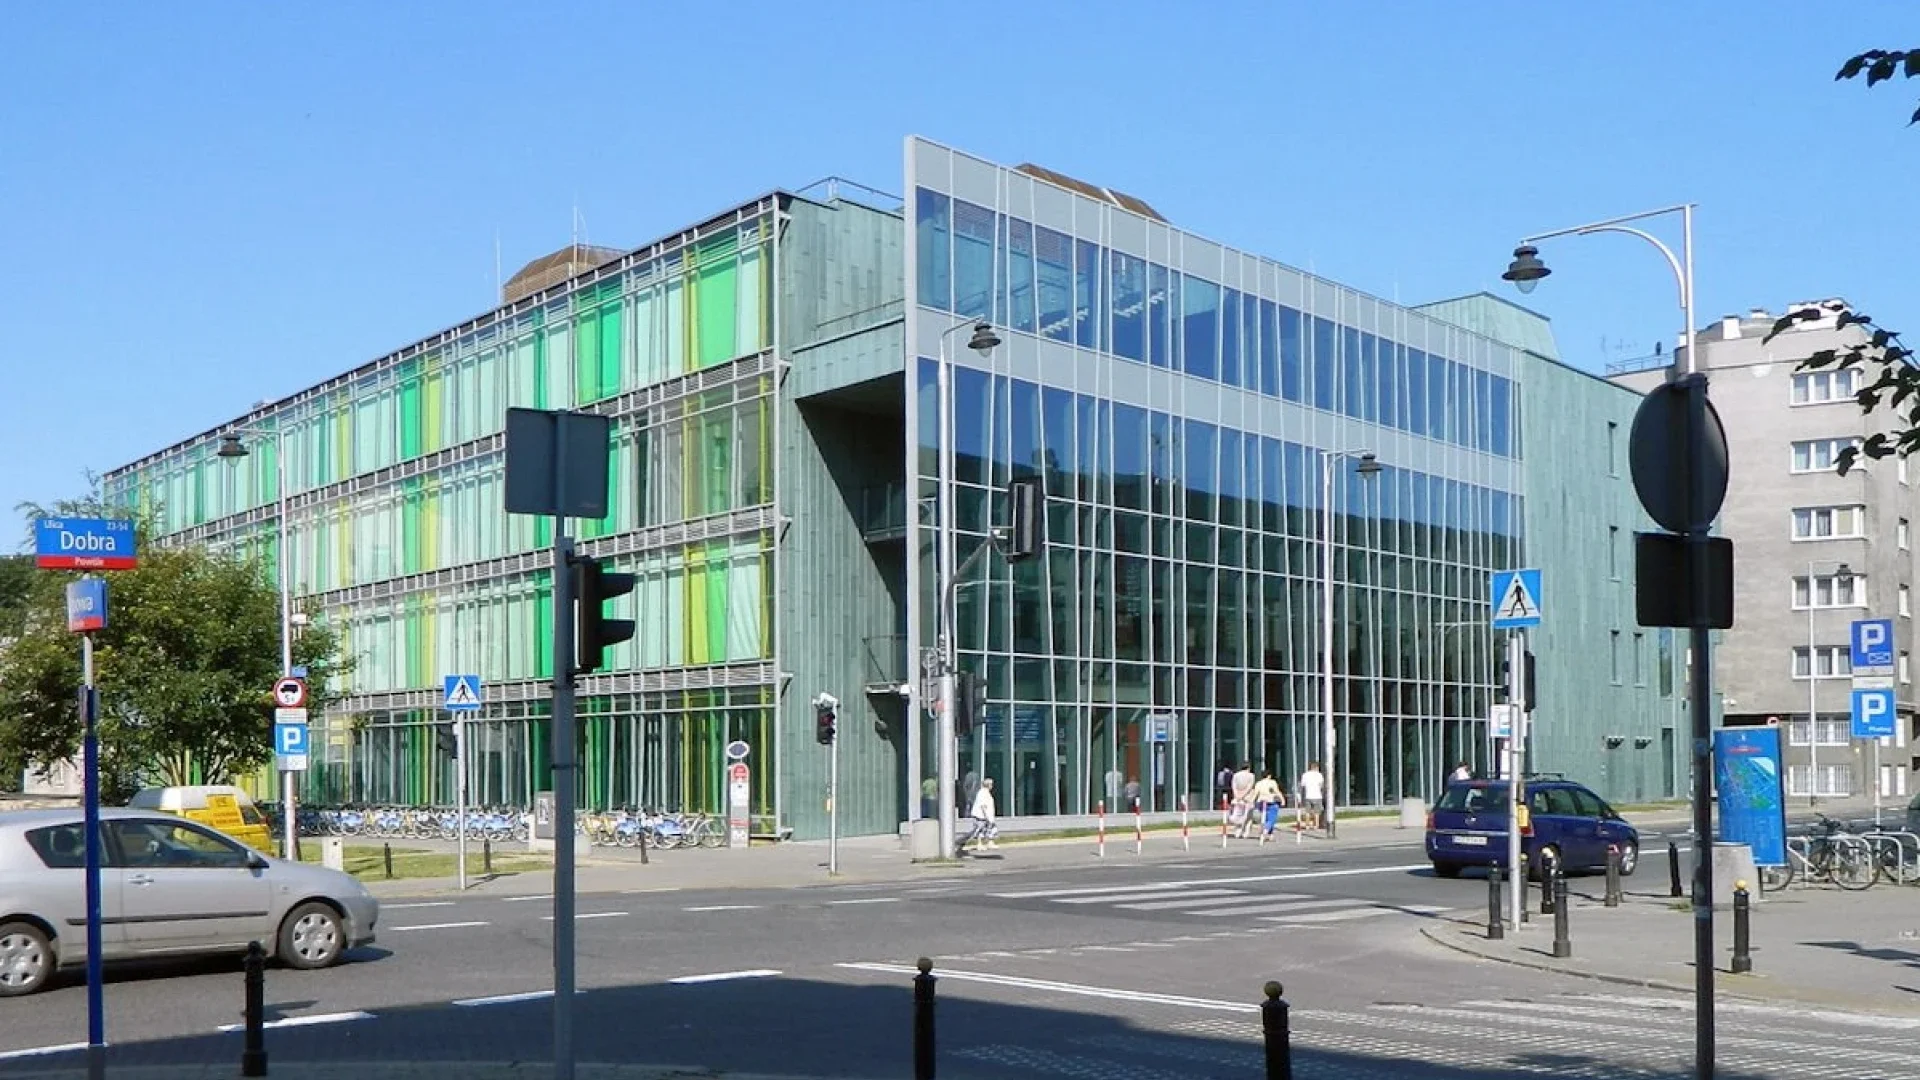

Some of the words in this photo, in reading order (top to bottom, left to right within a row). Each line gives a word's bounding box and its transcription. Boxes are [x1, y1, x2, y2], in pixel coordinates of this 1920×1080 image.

[60, 531, 116, 551] Dobra
[1861, 624, 1885, 654] P
[1861, 693, 1886, 724] P
[283, 727, 302, 752] P
